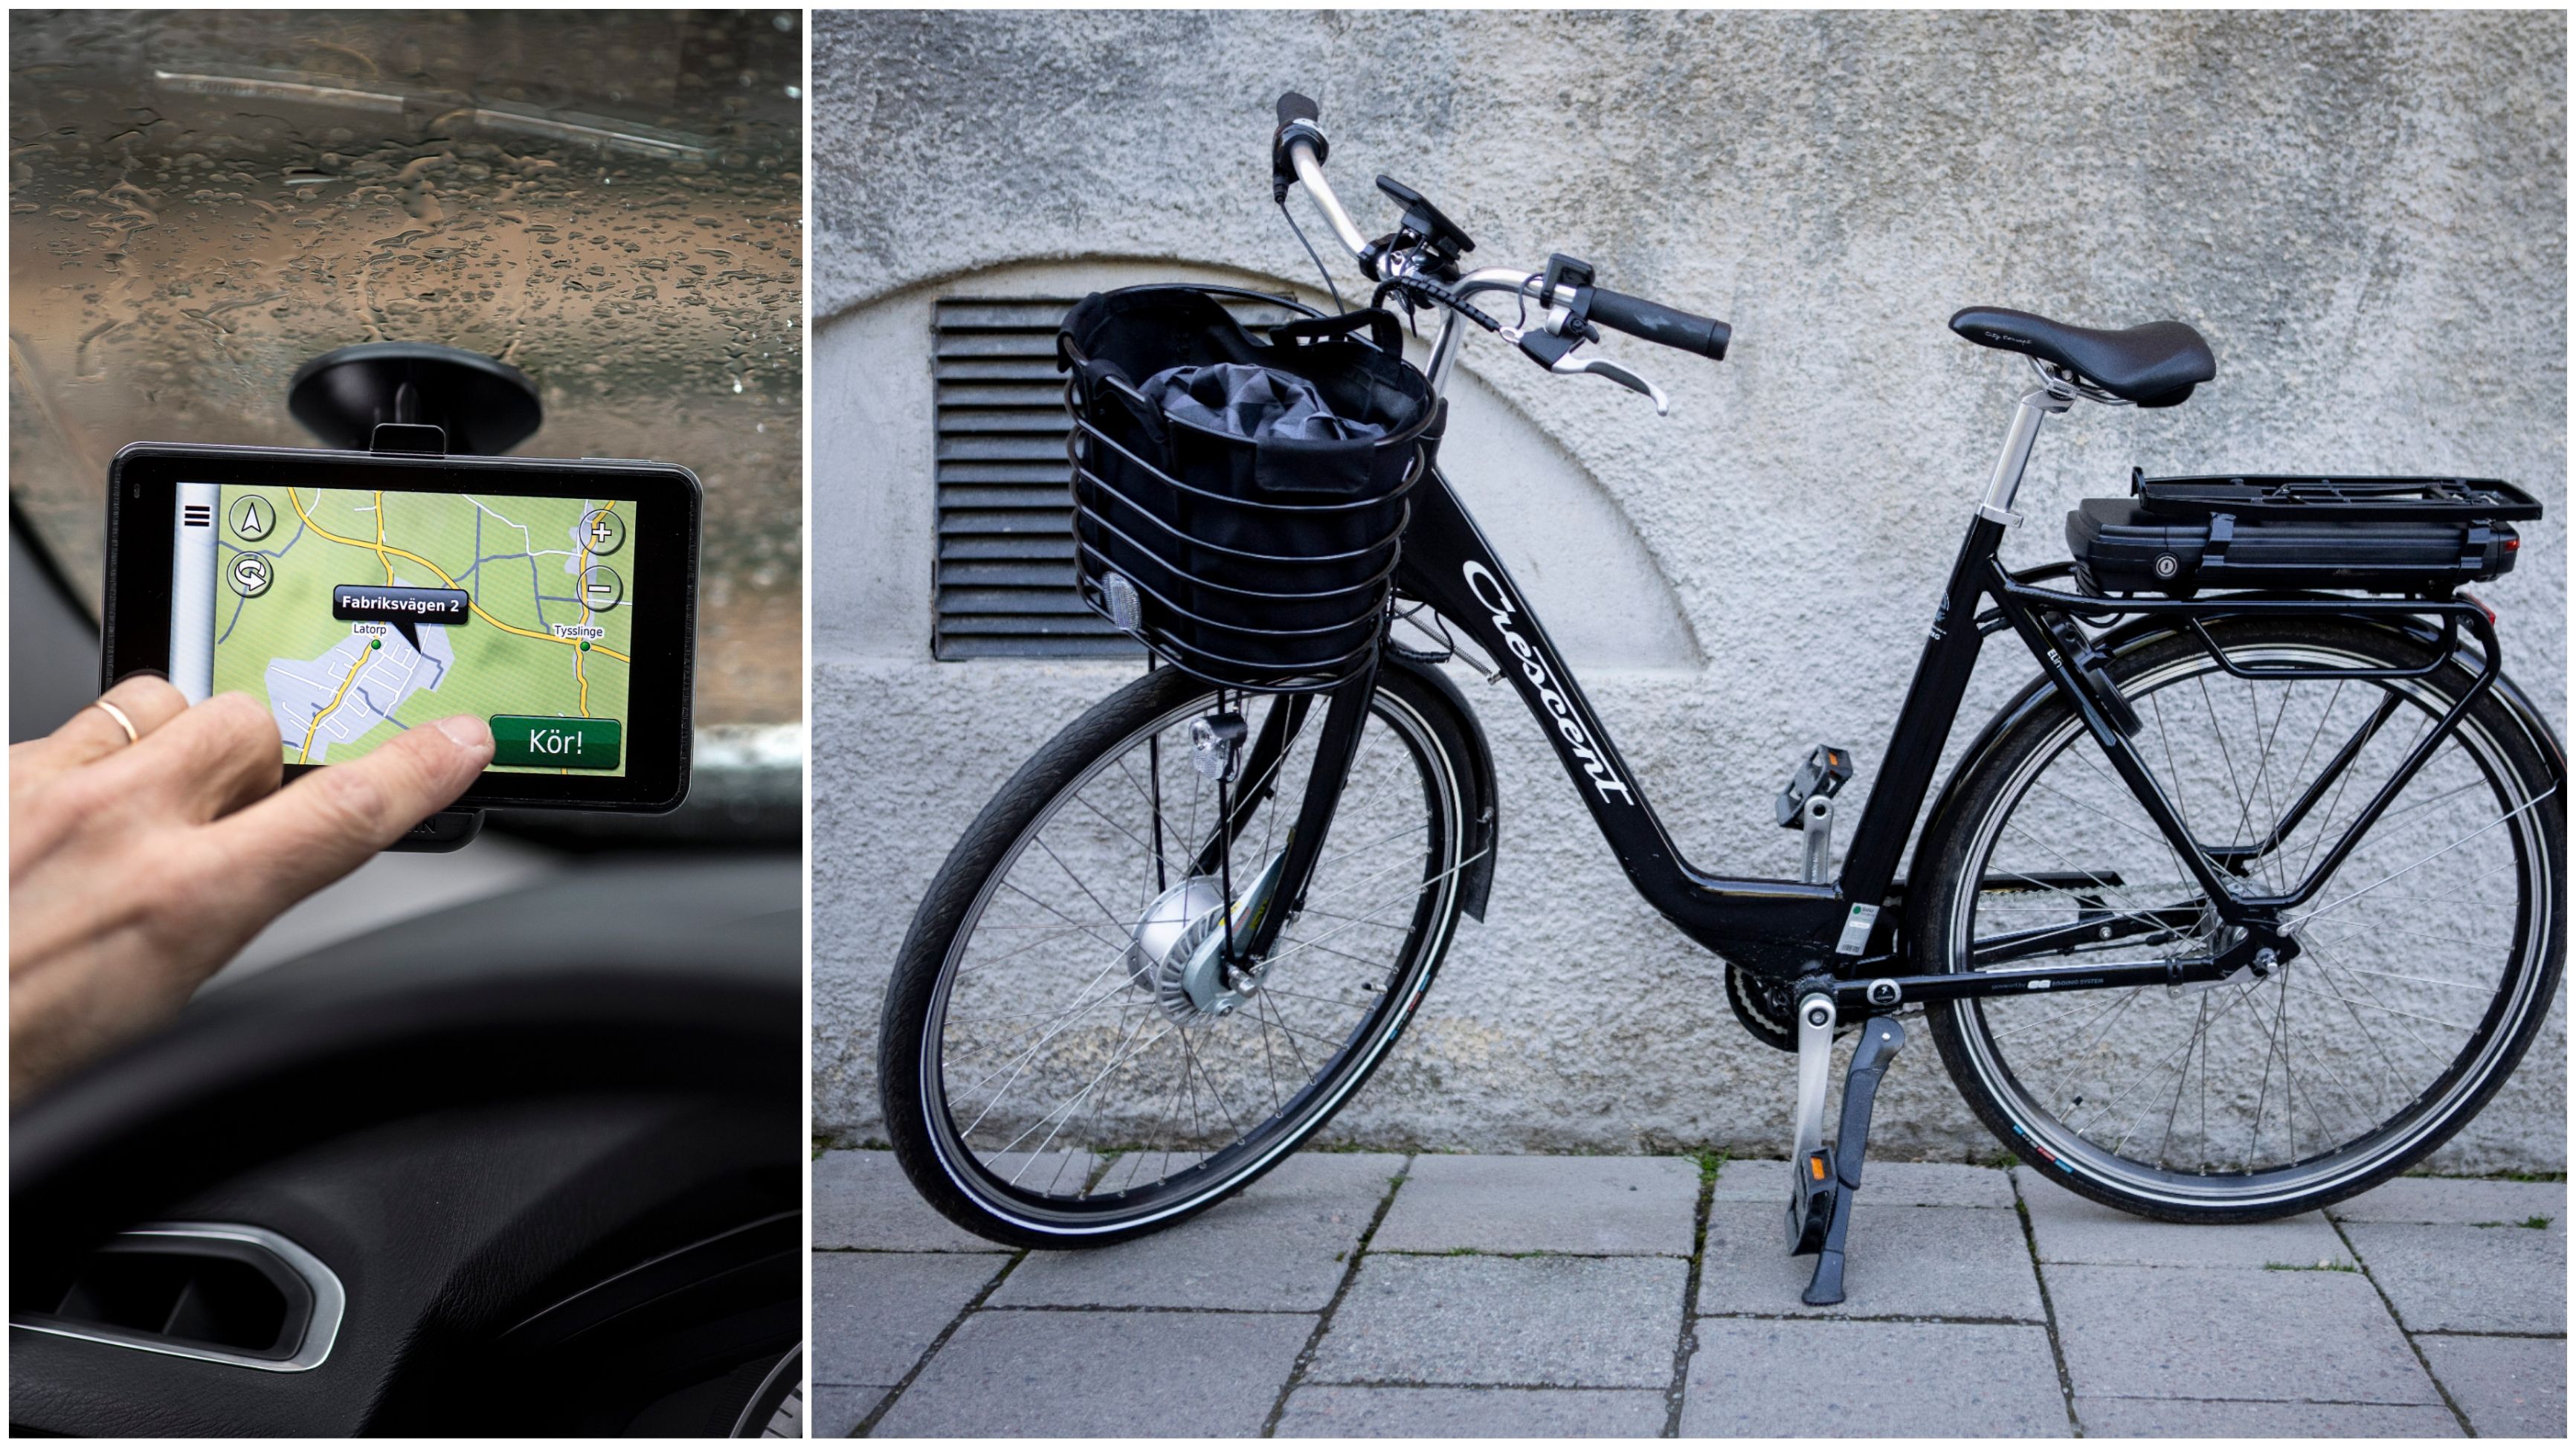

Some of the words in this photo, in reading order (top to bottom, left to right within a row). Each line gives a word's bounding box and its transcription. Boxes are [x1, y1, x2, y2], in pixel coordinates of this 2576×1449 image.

[342, 596, 445, 613] Fabriksvägen
[450, 599, 460, 612] 2
[353, 624, 387, 636] Latorp
[554, 625, 603, 638] Tysslinge
[1464, 560, 1634, 806] Crescent
[529, 729, 582, 755] Kör!
